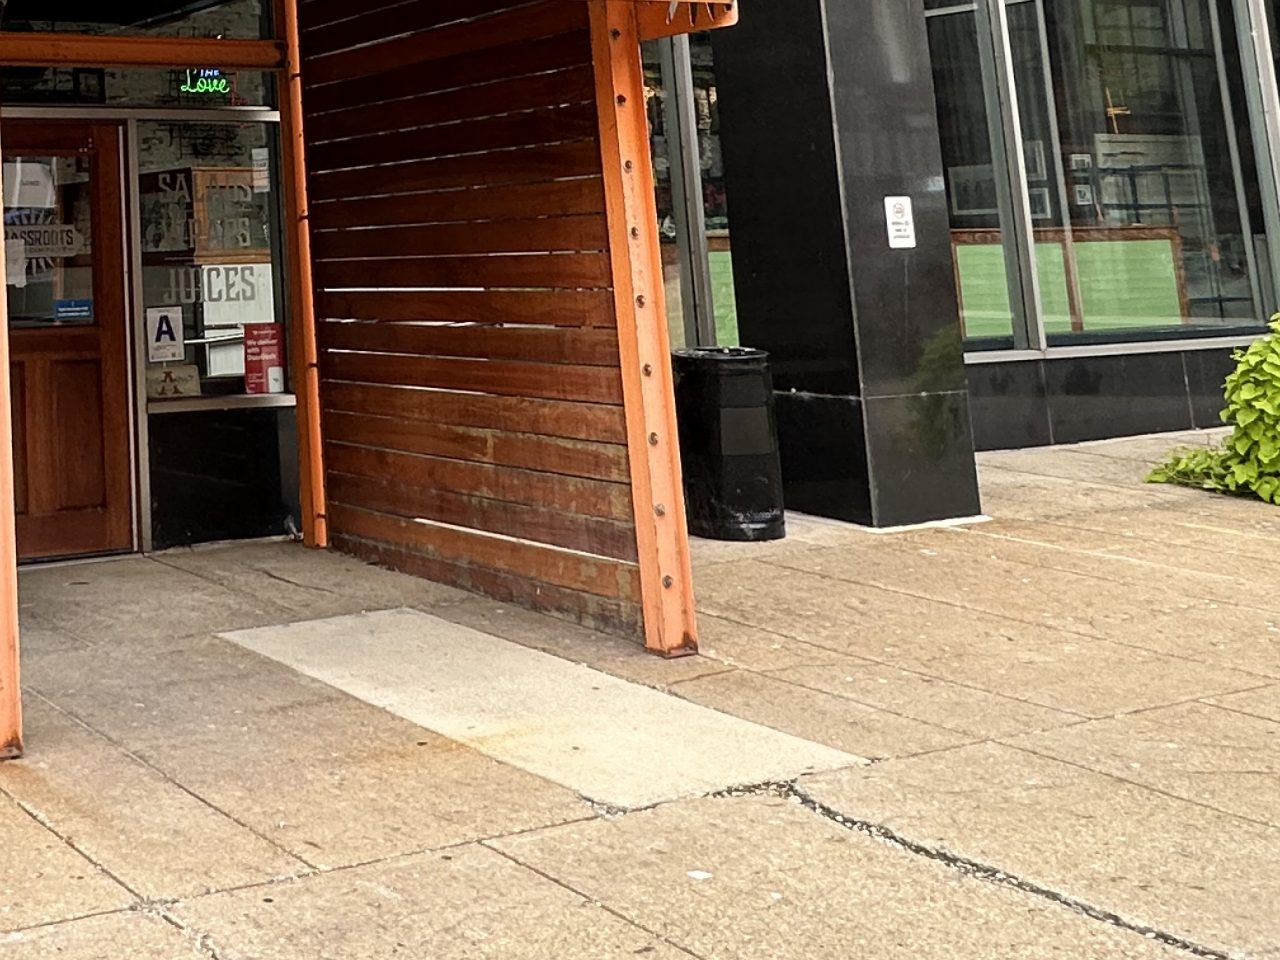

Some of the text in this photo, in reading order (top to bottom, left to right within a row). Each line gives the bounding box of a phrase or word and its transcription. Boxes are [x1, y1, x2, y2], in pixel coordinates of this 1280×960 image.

[180, 69, 230, 93] Love
[163, 266, 256, 304] JUICES
[155, 314, 177, 343] A
